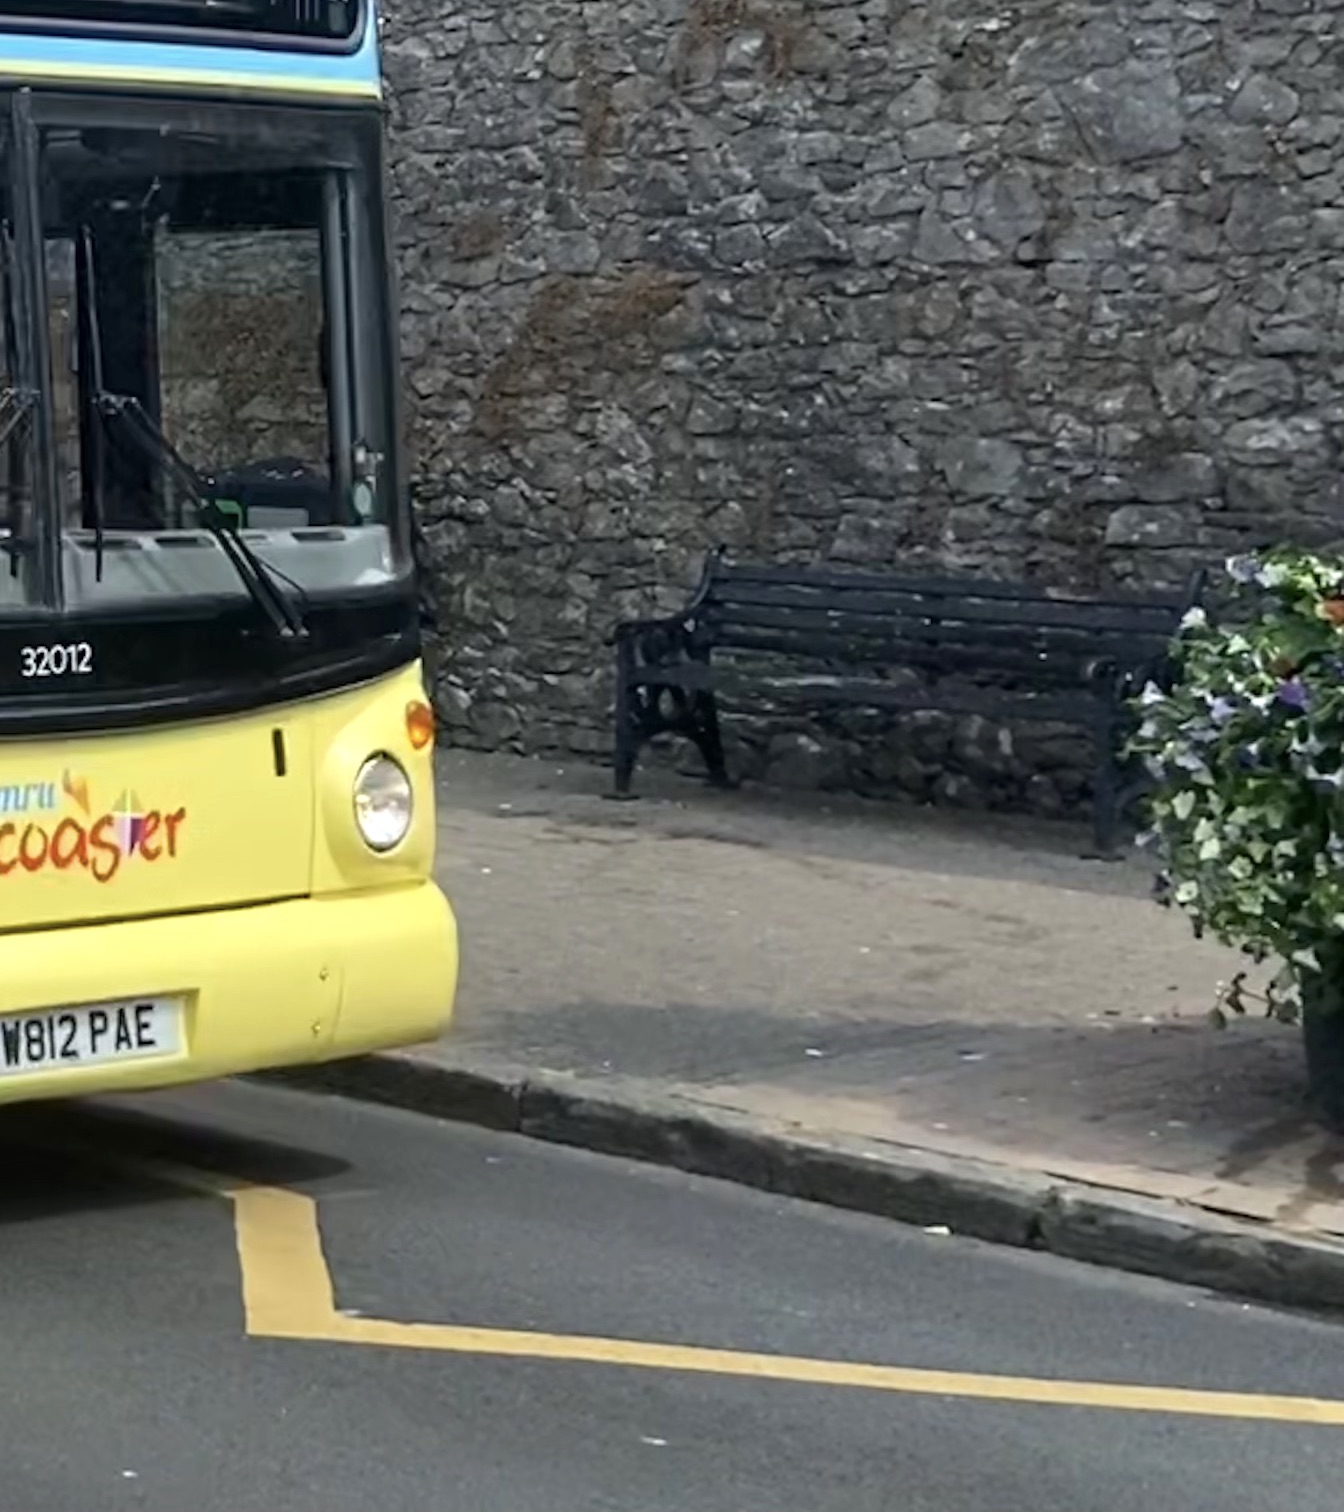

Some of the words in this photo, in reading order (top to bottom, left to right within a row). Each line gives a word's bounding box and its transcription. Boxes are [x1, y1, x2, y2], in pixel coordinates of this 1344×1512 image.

[21, 642, 92, 677] 32012
[2, 1014, 79, 1067] W812
[89, 1004, 156, 1054] PAE
